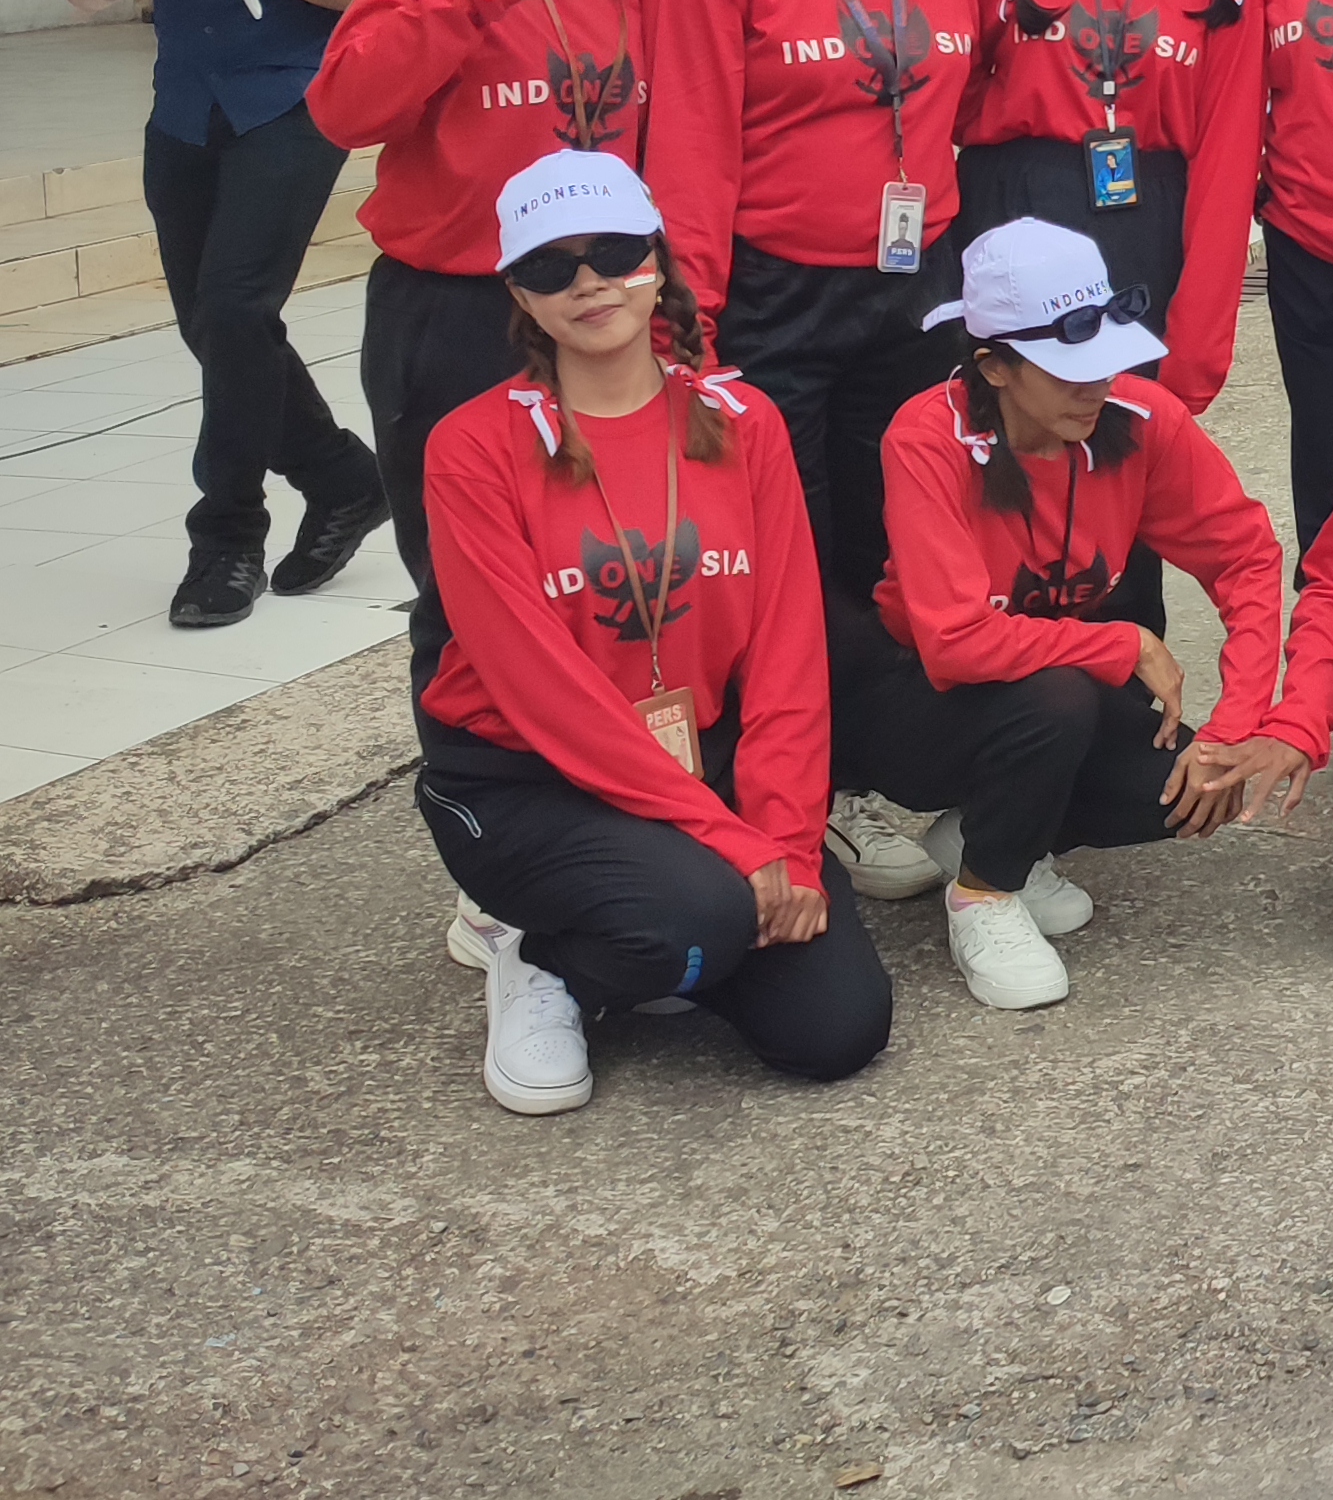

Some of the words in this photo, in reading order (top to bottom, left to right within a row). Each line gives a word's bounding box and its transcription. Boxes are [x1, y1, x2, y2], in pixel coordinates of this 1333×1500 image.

[481, 78, 648, 110] INDONES
[512, 183, 612, 223] INDONESIA
[543, 550, 749, 599] NDONESIA
[646, 703, 682, 725] PERS
